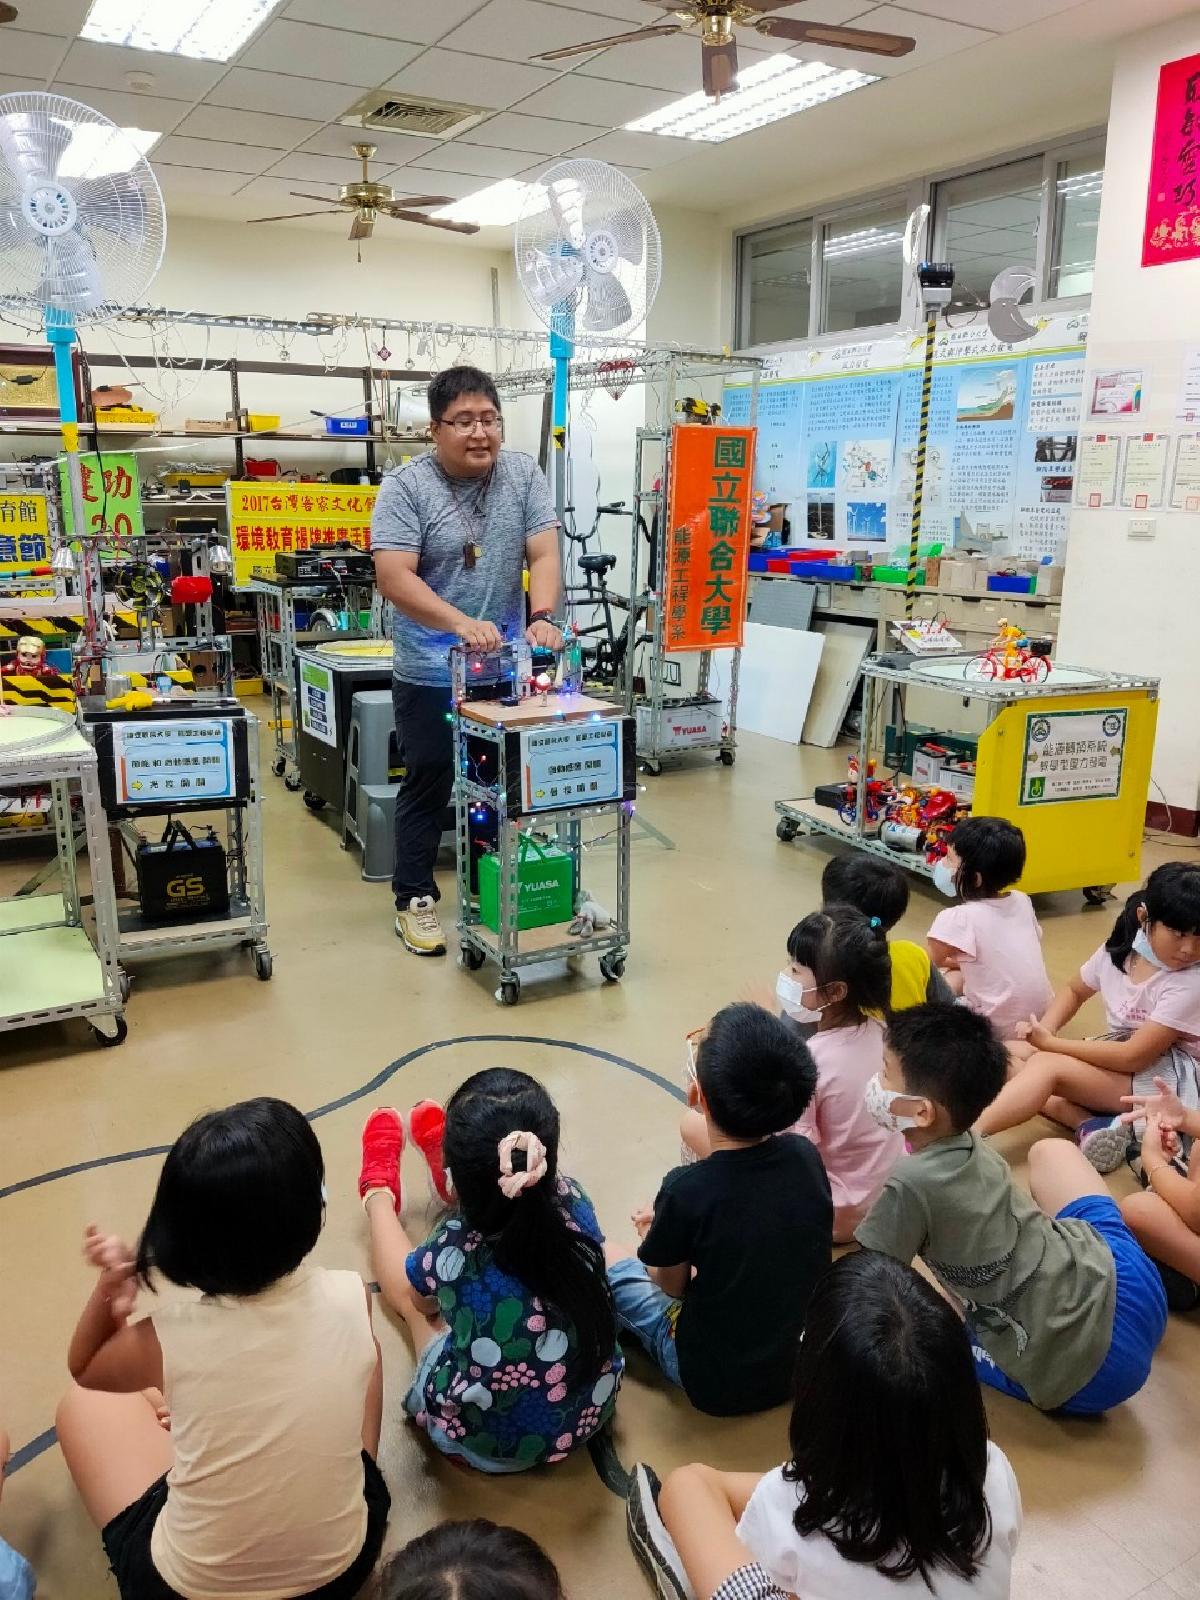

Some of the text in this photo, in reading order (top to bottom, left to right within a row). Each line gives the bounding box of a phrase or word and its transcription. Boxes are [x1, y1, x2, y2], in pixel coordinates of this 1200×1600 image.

[700, 436, 748, 636] 國立聯合大學
[671, 527, 691, 641] 能源工程學系
[682, 725, 707, 735] YUASA
[167, 877, 205, 897] GS
[525, 880, 560, 893] YUASA
